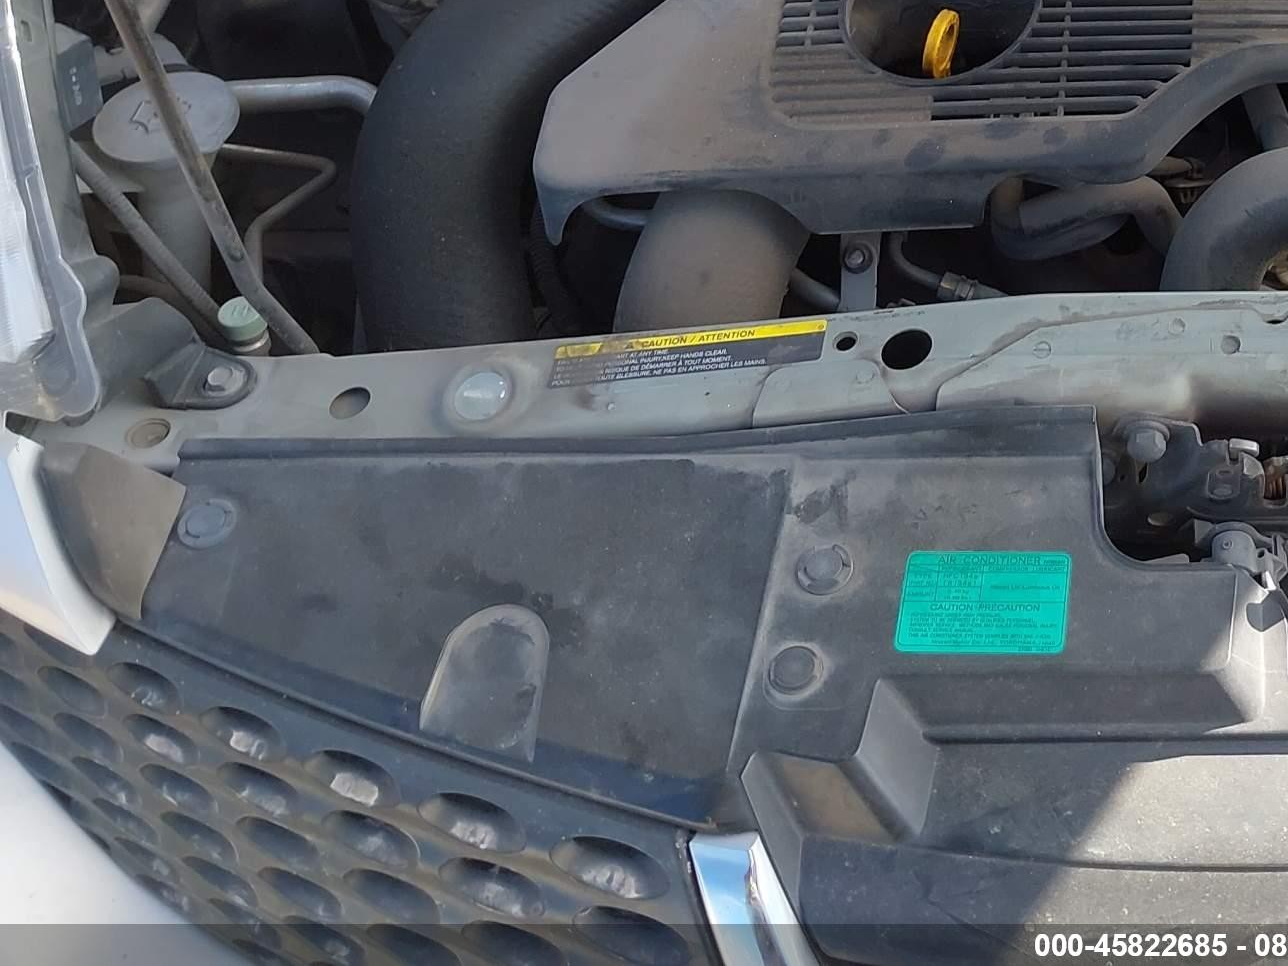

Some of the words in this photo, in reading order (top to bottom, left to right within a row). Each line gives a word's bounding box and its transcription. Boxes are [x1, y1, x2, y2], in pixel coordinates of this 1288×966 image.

[641, 336, 687, 348] CAUTION
[697, 330, 756, 343] ATTENTION
[938, 555, 957, 565] AIR
[963, 555, 1041, 566] CONDITIONER
[979, 604, 1040, 612] PRECAUTION
